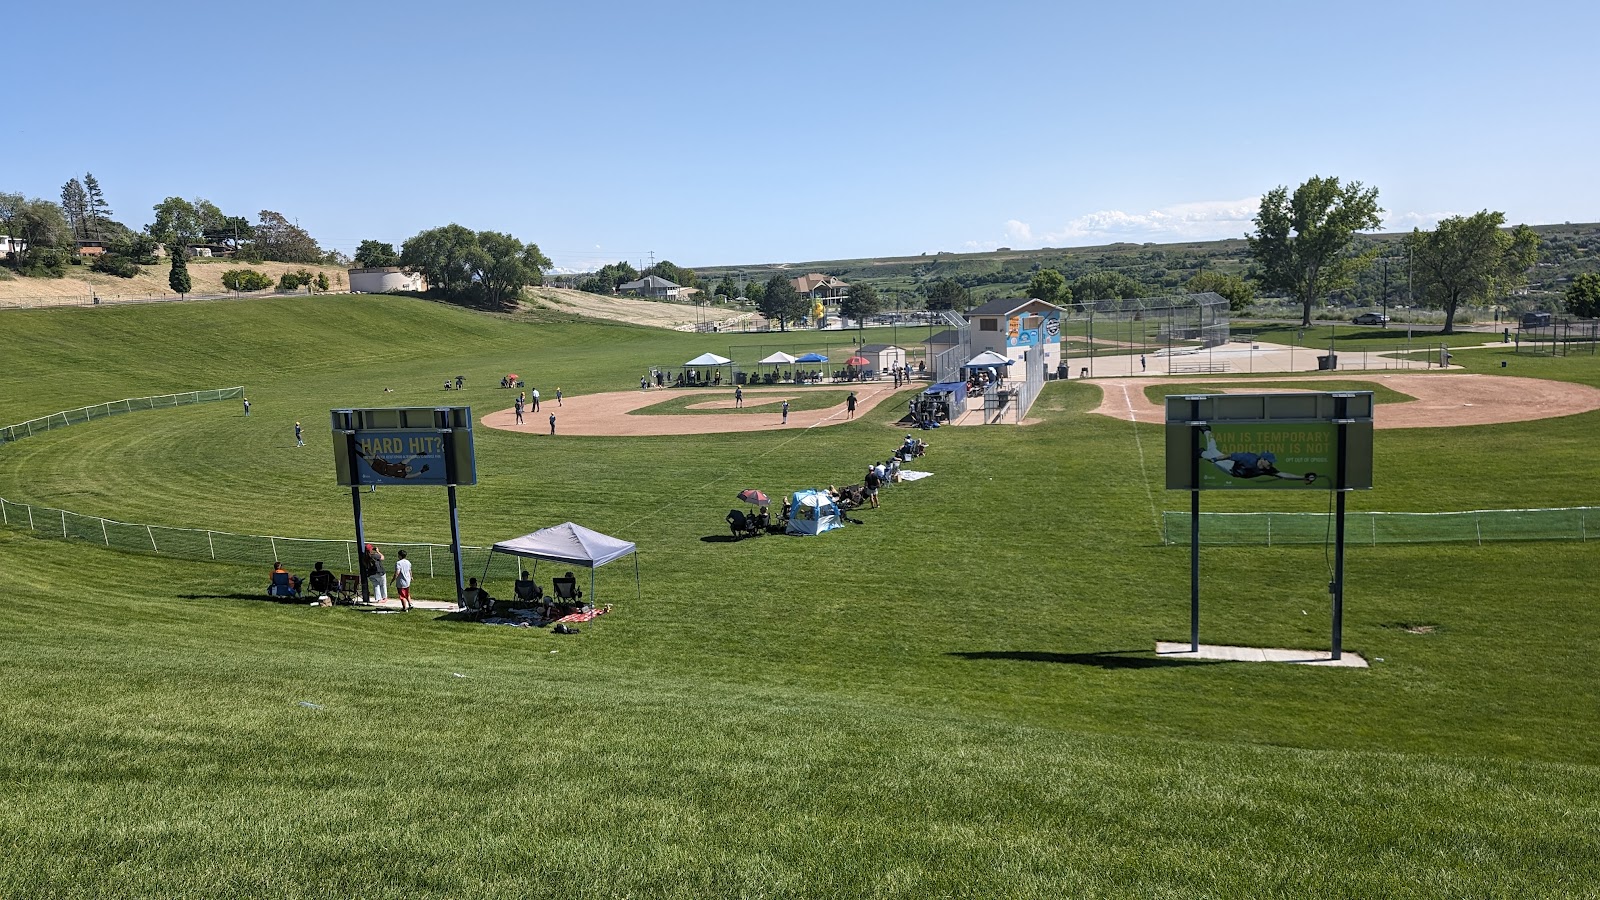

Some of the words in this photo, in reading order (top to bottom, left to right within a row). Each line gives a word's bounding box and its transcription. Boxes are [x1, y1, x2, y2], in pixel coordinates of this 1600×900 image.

[1240, 432, 1251, 443] IS
[1256, 432, 1330, 443] TEMPORARY
[361, 437, 402, 453] HARD
[409, 437, 441, 452] HIT?
[1221, 443, 1284, 454] ADDICTION
[1289, 443, 1301, 454] IS
[1306, 443, 1330, 454] NOT
